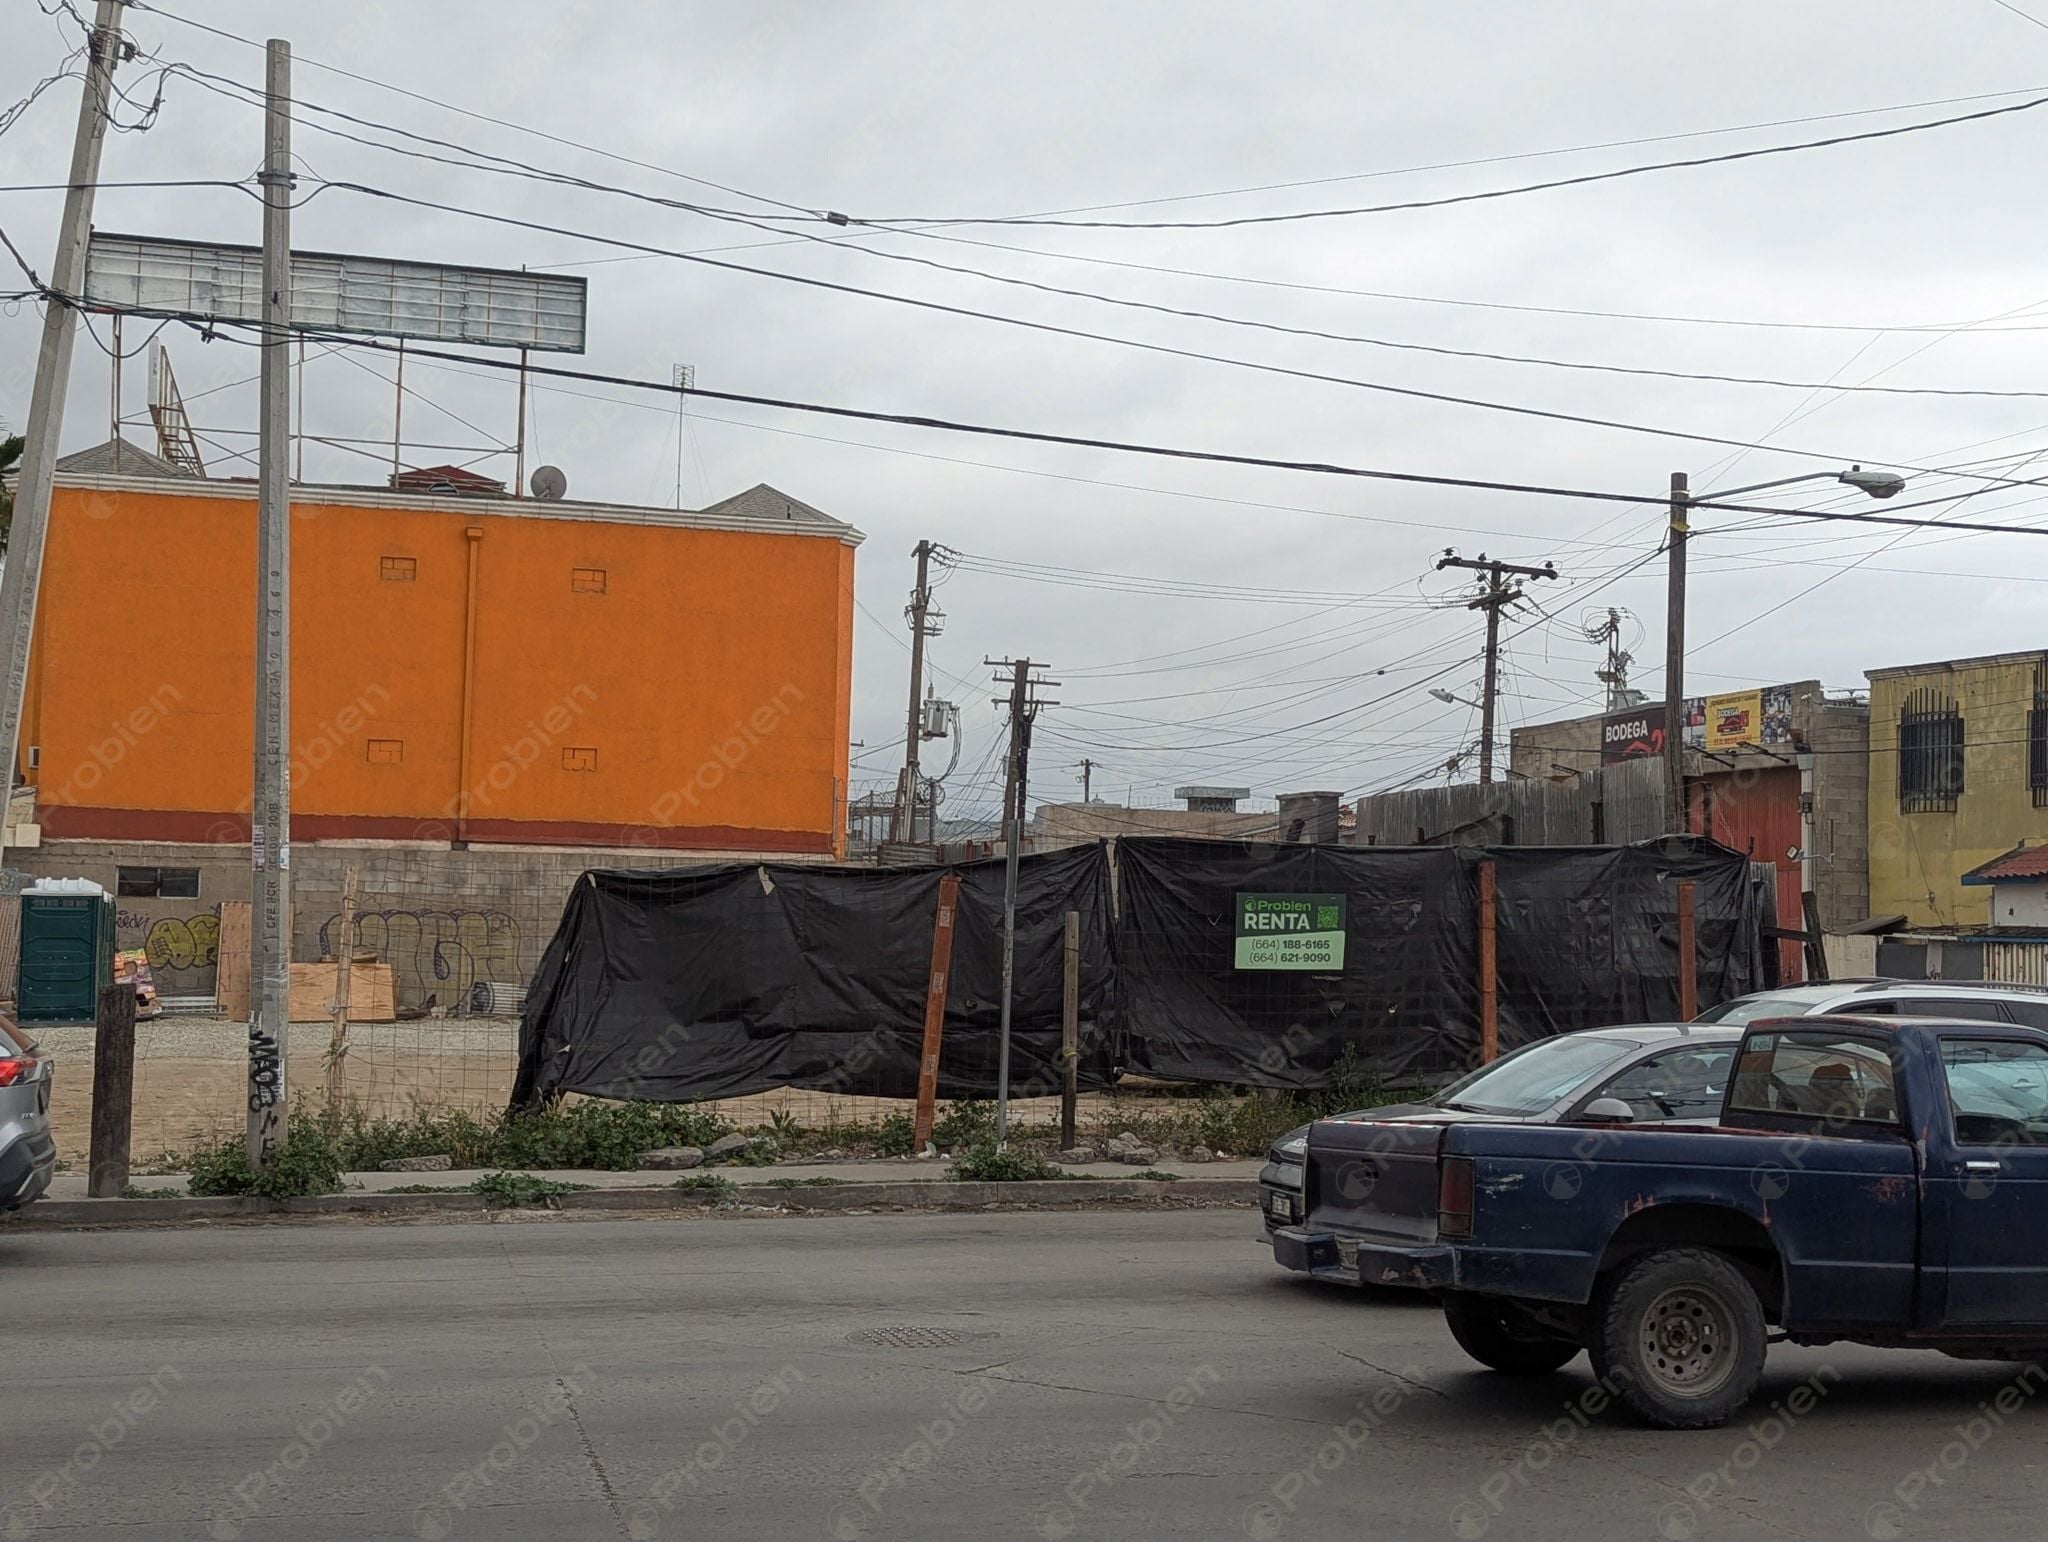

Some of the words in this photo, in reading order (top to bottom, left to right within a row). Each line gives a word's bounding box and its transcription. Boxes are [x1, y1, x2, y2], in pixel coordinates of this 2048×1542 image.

[1605, 720, 1648, 743] BODEGA
[1258, 900, 1312, 911] Probien
[1244, 913, 1311, 930] RENTA
[1251, 939, 1280, 950] (664)
[1282, 940, 1330, 949] 188-6165
[1250, 952, 1278, 964] (664)
[1280, 953, 1331, 963] 621-9090
